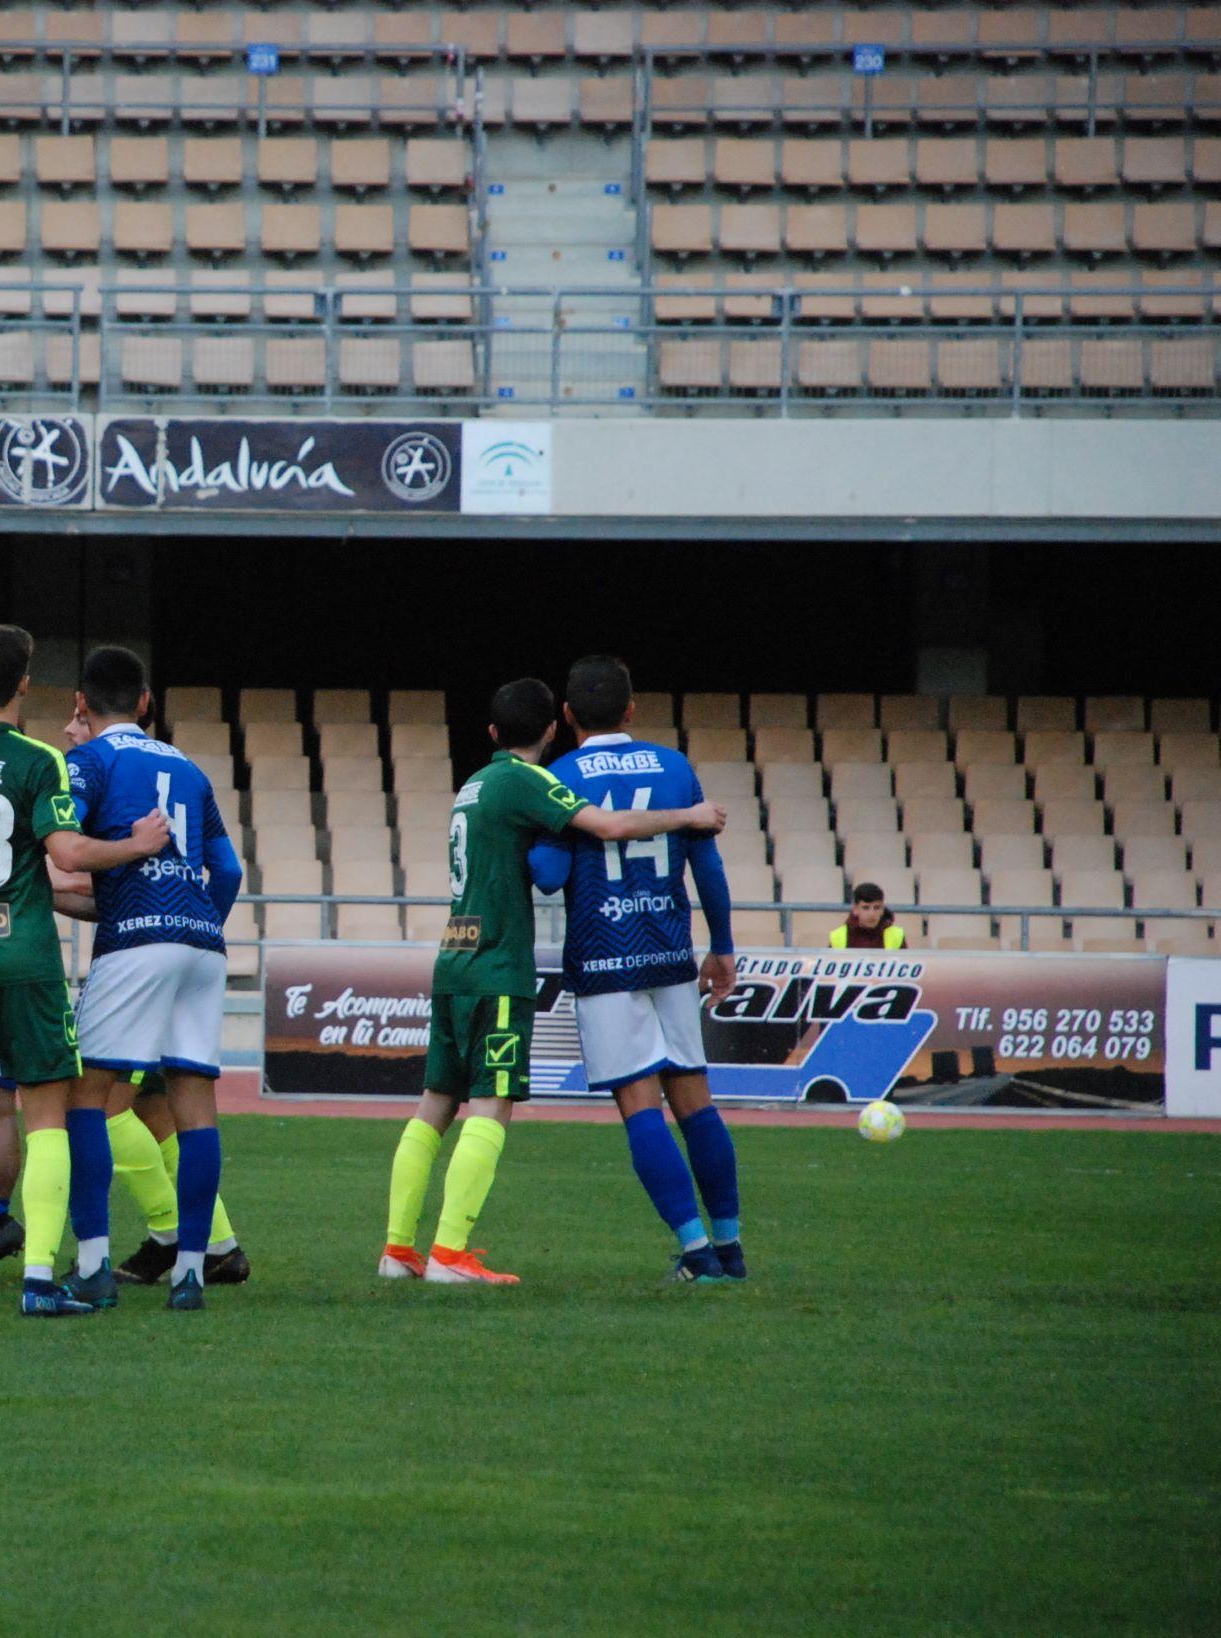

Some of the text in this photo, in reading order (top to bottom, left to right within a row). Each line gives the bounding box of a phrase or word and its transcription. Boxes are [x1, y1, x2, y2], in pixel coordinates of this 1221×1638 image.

[107, 434, 356, 496] Andalucía
[600, 787, 670, 881] 14
[118, 915, 162, 933] XEREZ
[582, 957, 623, 972] XEREZ
[626, 948, 689, 968] DEPORTIVO
[736, 956, 803, 977] Grupo
[285, 983, 313, 1018] Te
[955, 1007, 1155, 1034] Tlf. 956 270 533
[320, 1025, 348, 1046] en
[998, 1035, 1152, 1060] 622 064 079
